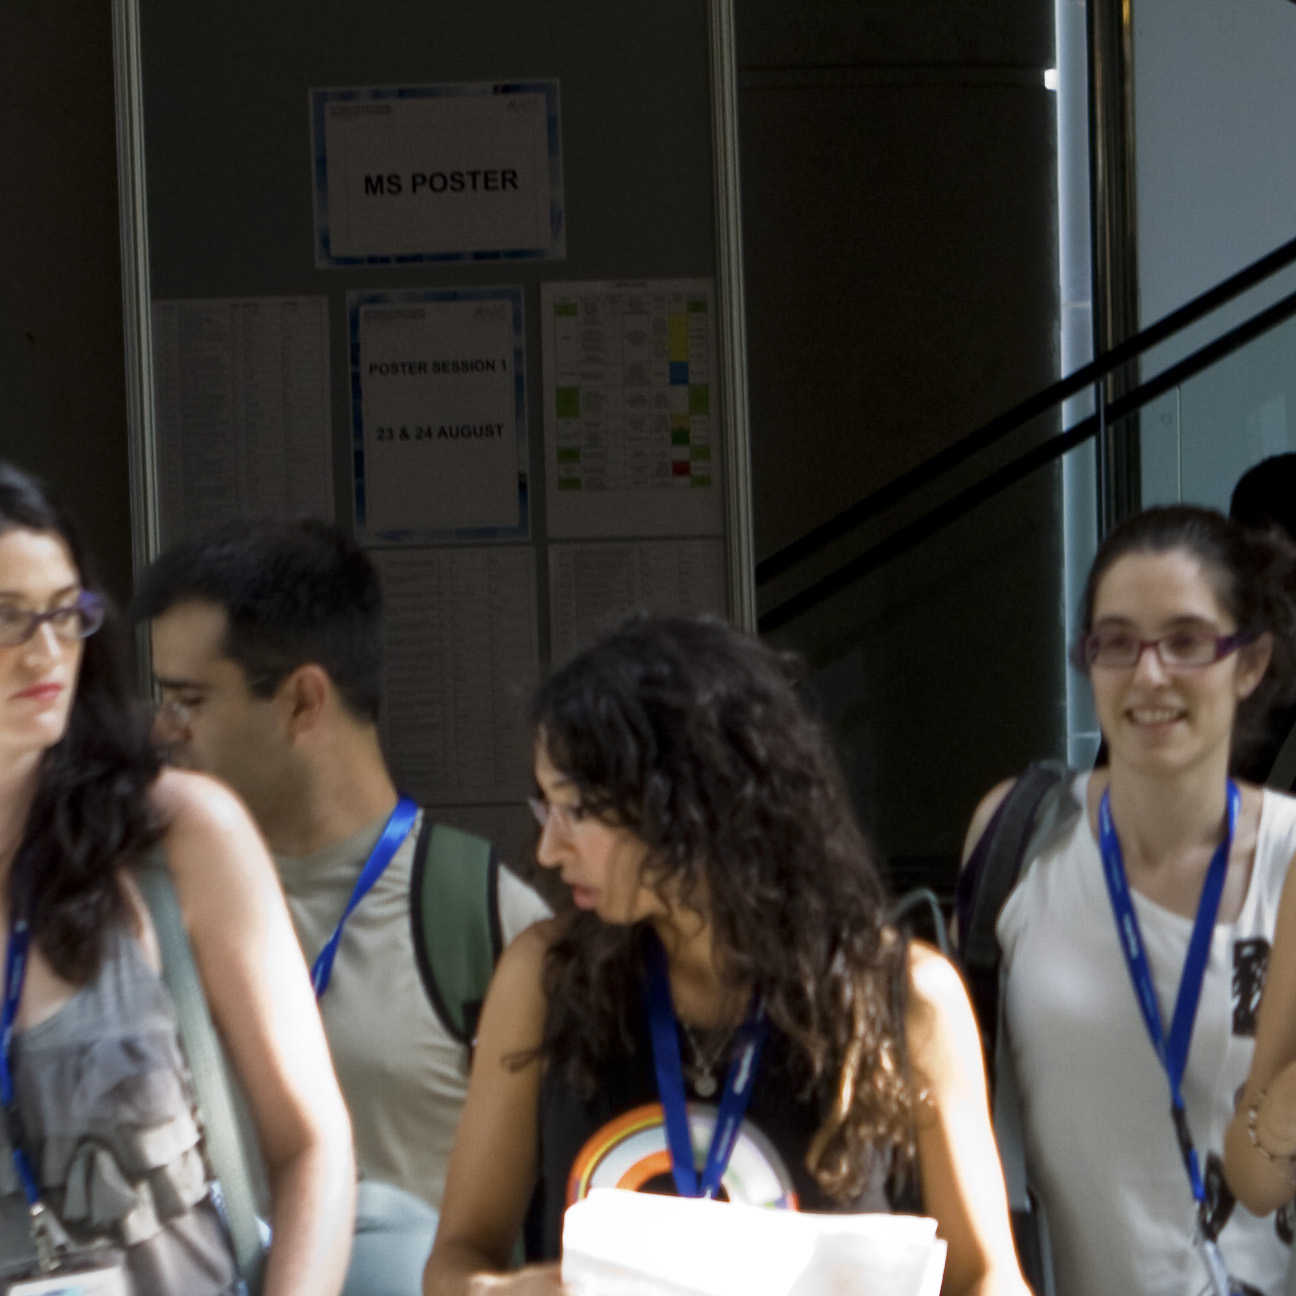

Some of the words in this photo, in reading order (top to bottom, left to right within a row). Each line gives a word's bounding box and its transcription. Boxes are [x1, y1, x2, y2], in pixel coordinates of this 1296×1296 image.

[364, 173, 402, 195] MS
[410, 168, 519, 193] POSTER
[369, 360, 427, 376] POSTER
[431, 358, 497, 374] SESSION
[376, 426, 395, 441] 23
[399, 426, 410, 440] &
[415, 425, 433, 440] 24
[436, 423, 505, 440] AUGUST
